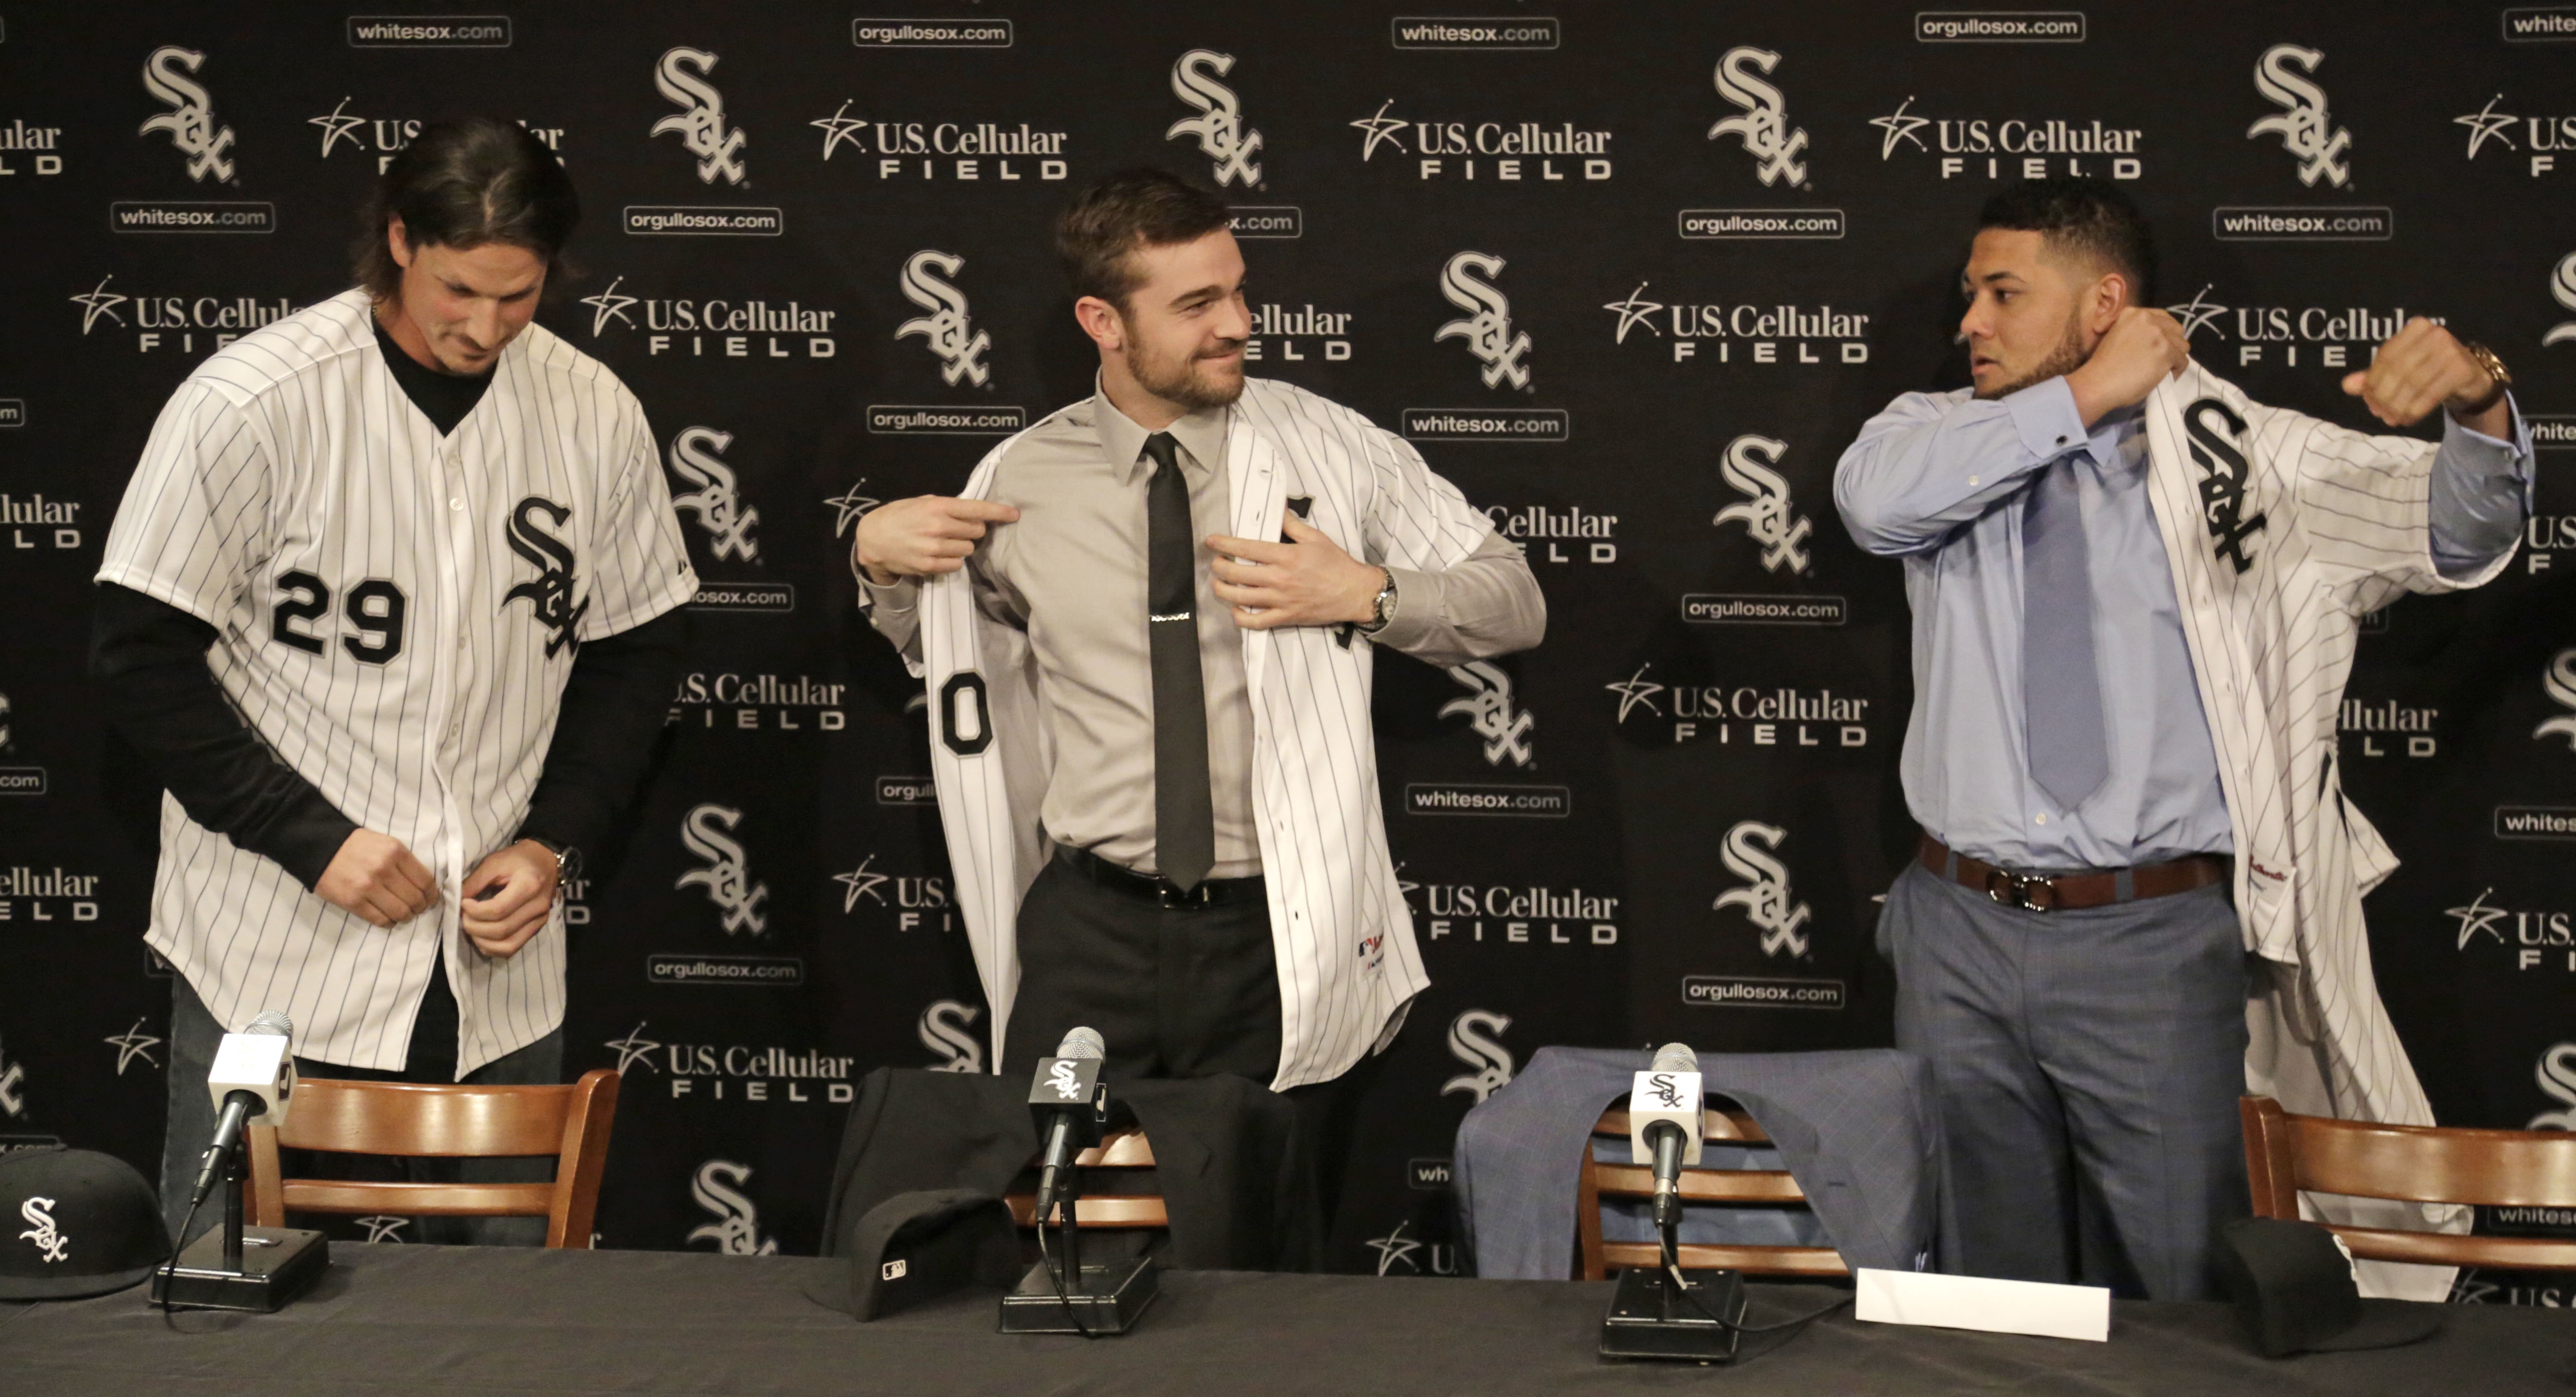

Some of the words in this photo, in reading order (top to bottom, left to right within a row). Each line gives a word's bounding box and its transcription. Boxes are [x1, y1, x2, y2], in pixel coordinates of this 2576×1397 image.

[357, 24, 501, 39] whitesox.com
[860, 26, 1005, 43] orgullosox.com
[1402, 25, 1549, 41] whitesox.com
[1923, 19, 2077, 38] orgullosox.com
[0, 119, 61, 150] ular
[374, 120, 421, 151] U.S
[876, 123, 930, 154] U.S.
[934, 124, 1067, 154] Cellular
[1417, 123, 1471, 154] U.S.
[1476, 123, 1611, 154] Cellular
[1938, 120, 1995, 152] U.S.
[1999, 120, 2142, 153] Cellular
[2529, 117, 2576, 150] U.S
[880, 160, 1067, 180] FIELD
[1421, 160, 1611, 180] FIELD
[121, 209, 265, 224] whitesox.com
[630, 213, 776, 231] orgullosox.com
[1686, 216, 1837, 234] orgullosox.com
[2224, 215, 2381, 231] whitesox.com
[137, 298, 189, 328] U.S.
[193, 297, 302, 328] Cellul
[646, 300, 699, 330] U.S.
[704, 301, 835, 332] Cellular
[1250, 304, 1352, 336] ellular
[1672, 306, 1726, 337] U.S.
[1731, 306, 1869, 337] Cellular
[2238, 308, 2294, 340] U.S.
[2300, 307, 2446, 341] Cellul
[650, 336, 835, 357] FIELD
[1244, 340, 1352, 362] ELD
[1675, 342, 1868, 363] FIELD
[2240, 346, 2378, 367] FIE
[874, 412, 1018, 430] orgullosox.com
[1412, 416, 1559, 432] whitesox.com
[0, 494, 80, 523] lular
[2528, 516, 2576, 548] U.S
[693, 589, 787, 604] losox.com
[269, 567, 409, 668] 29
[1689, 602, 1838, 619] orgullosox.com
[715, 674, 845, 705] Cellular
[1675, 687, 1727, 718] U.S.
[1732, 689, 1868, 721] Cellular
[2340, 698, 2438, 732] llular
[1676, 724, 1866, 746] FIELD
[1416, 791, 1560, 807] whitesox.com
[2506, 814, 2576, 831] whites
[0, 867, 98, 896] ellular
[898, 878, 944, 907] U.S.
[0, 901, 98, 921] ELD
[1429, 886, 1480, 916] U.S.
[1485, 887, 1618, 919] Cellular
[1431, 921, 1617, 944] FIELD
[2519, 913, 2574, 945] U.S.
[654, 962, 797, 980] orgullosox.com
[1689, 984, 1838, 1003] orgullosox.com
[670, 1045, 720, 1075] U.S.
[725, 1047, 853, 1078] Cellular
[672, 1080, 853, 1102] FIELD
